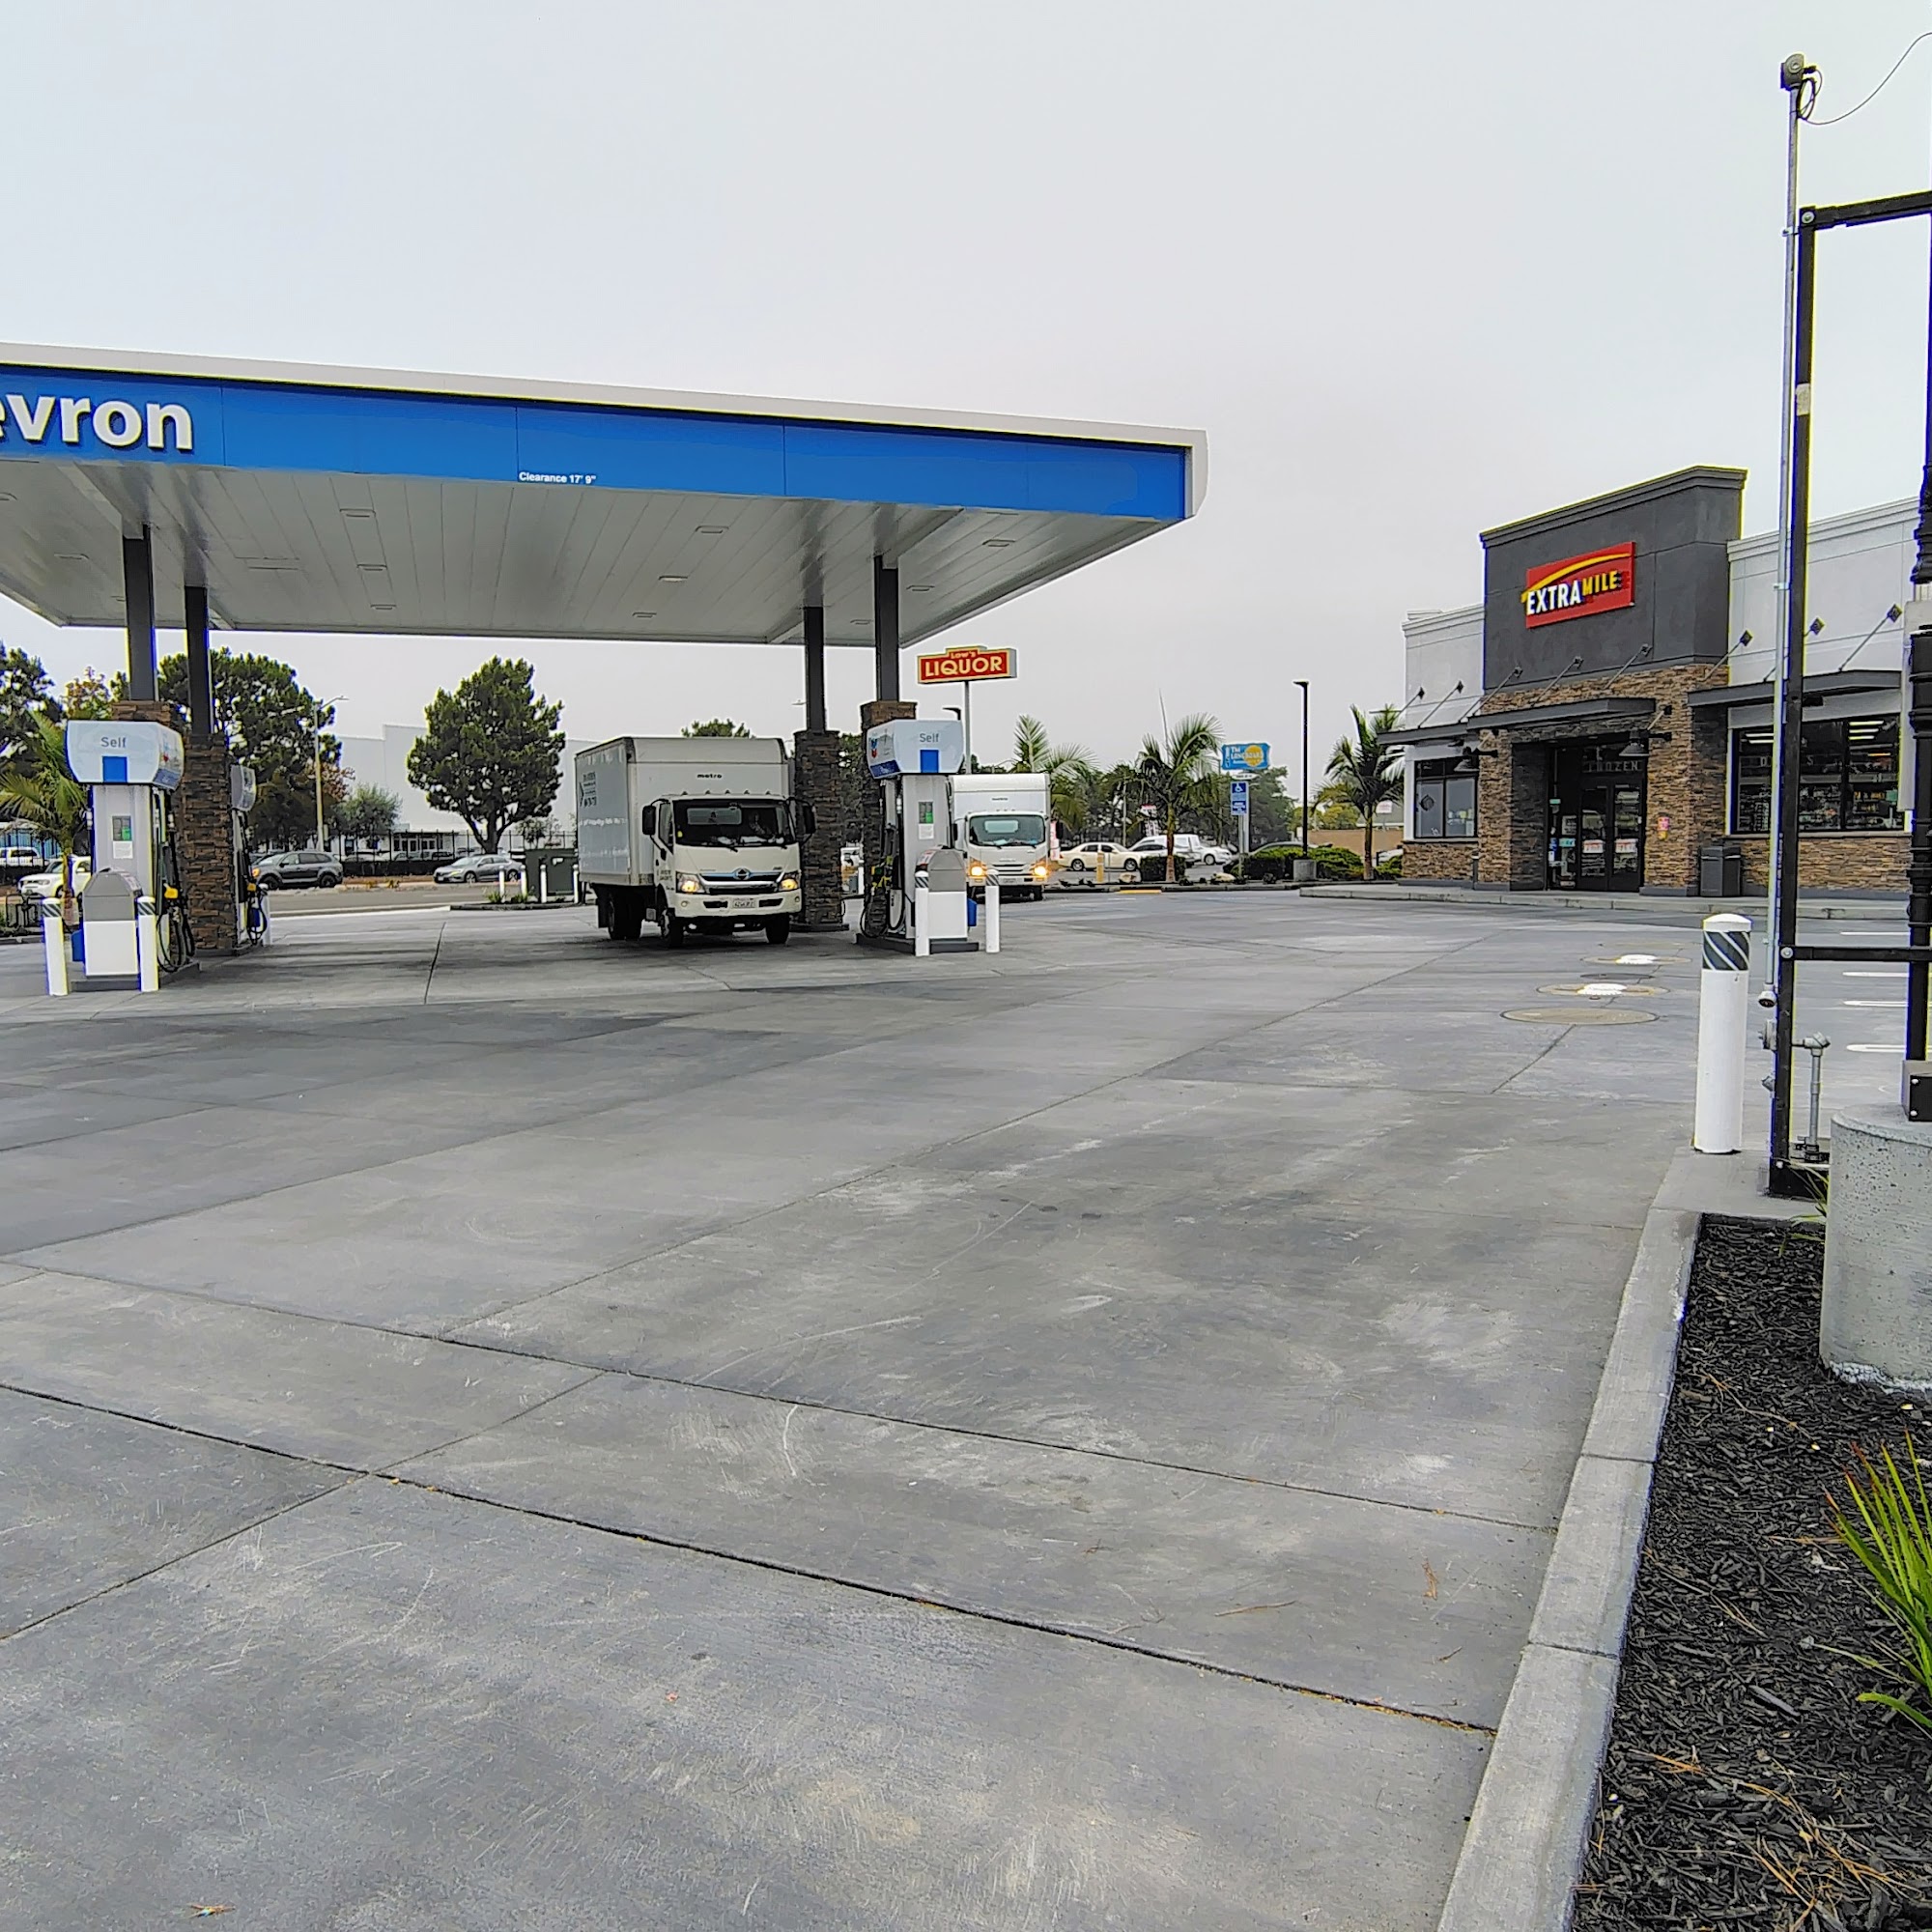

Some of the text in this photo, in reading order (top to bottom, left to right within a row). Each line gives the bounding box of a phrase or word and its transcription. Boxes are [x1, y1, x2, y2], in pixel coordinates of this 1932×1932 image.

[0, 394, 193, 450] vron
[519, 471, 568, 483] Clearance
[925, 656, 1002, 677] LIQUOR
[100, 737, 127, 748] Self
[920, 732, 940, 743] Self
